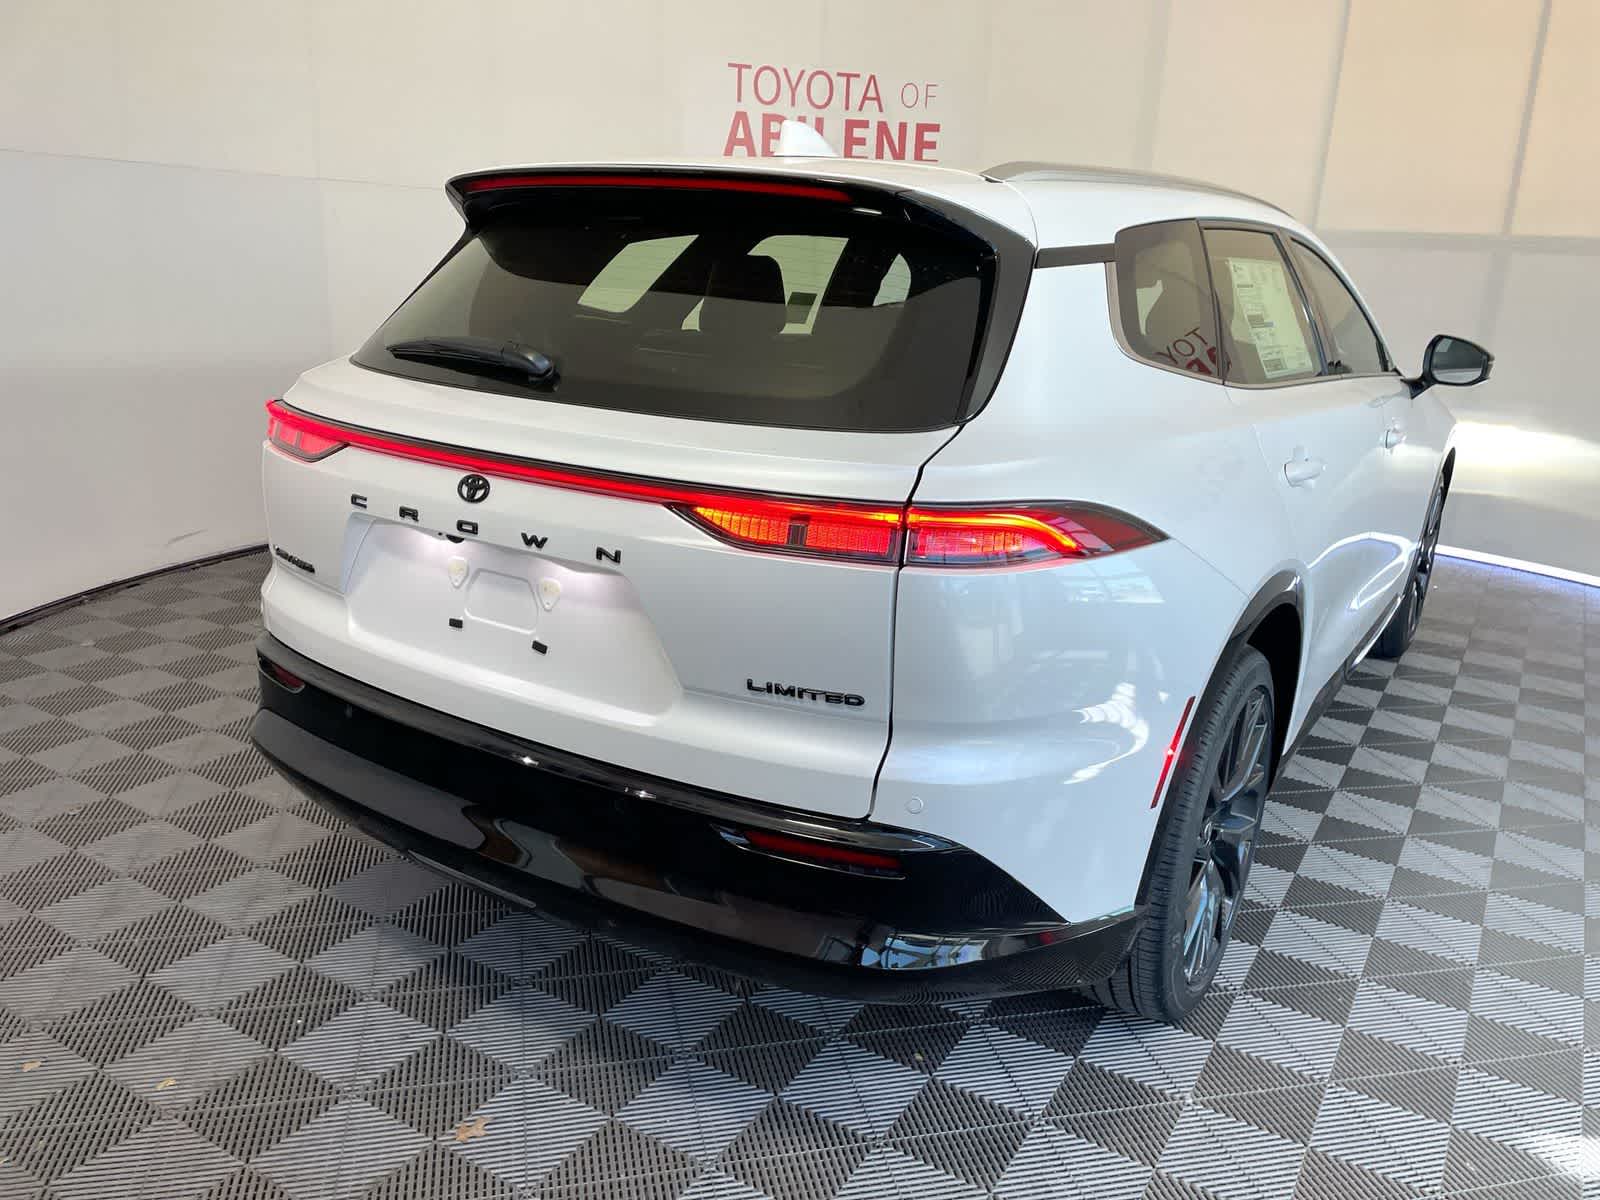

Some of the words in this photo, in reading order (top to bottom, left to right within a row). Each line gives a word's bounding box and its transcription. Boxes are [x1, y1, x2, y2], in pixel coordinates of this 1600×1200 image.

[728, 63, 883, 112] TOYOTA
[901, 82, 938, 109] OF
[723, 111, 941, 162] ABENE
[350, 493, 621, 564] CROWN
[746, 678, 866, 706] LIMITED
